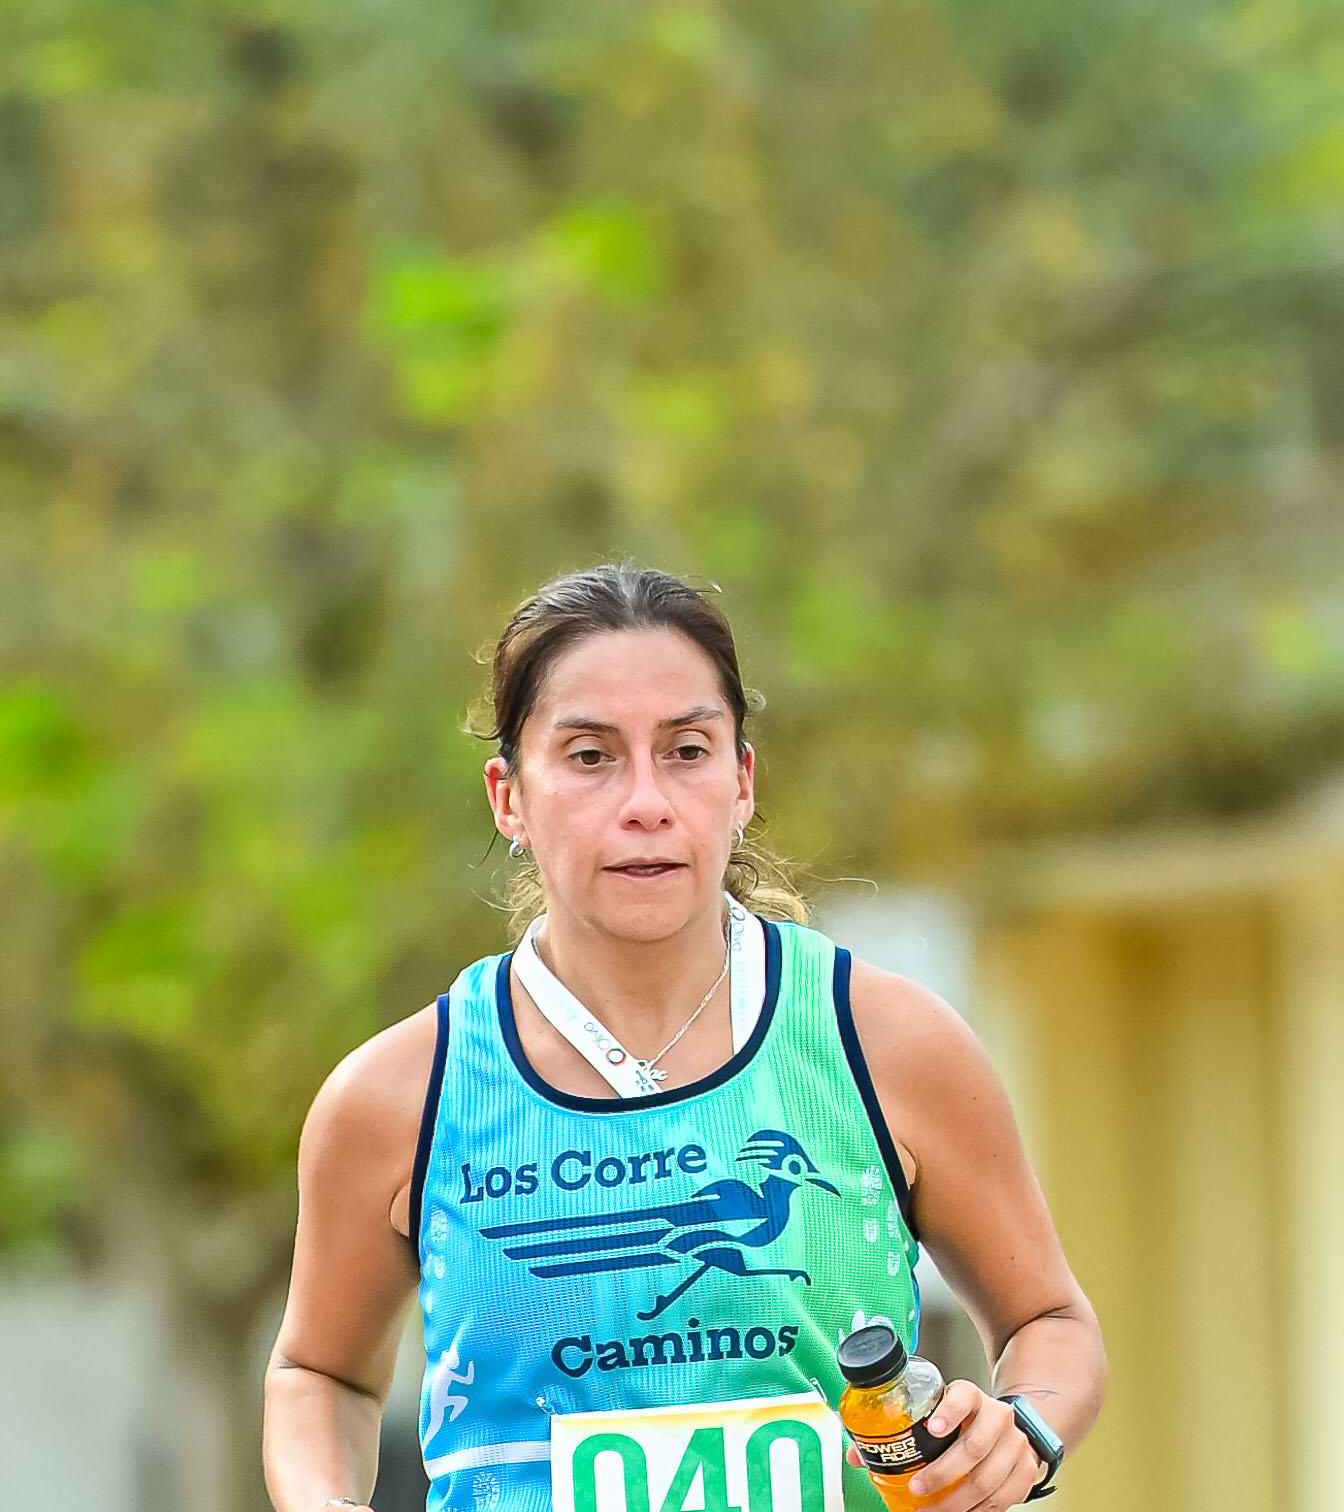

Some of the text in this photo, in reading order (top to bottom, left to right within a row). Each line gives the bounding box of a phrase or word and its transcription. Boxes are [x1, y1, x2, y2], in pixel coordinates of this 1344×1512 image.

[459, 1143, 708, 1205] Los Corre
[551, 1317, 800, 1379] Caminos
